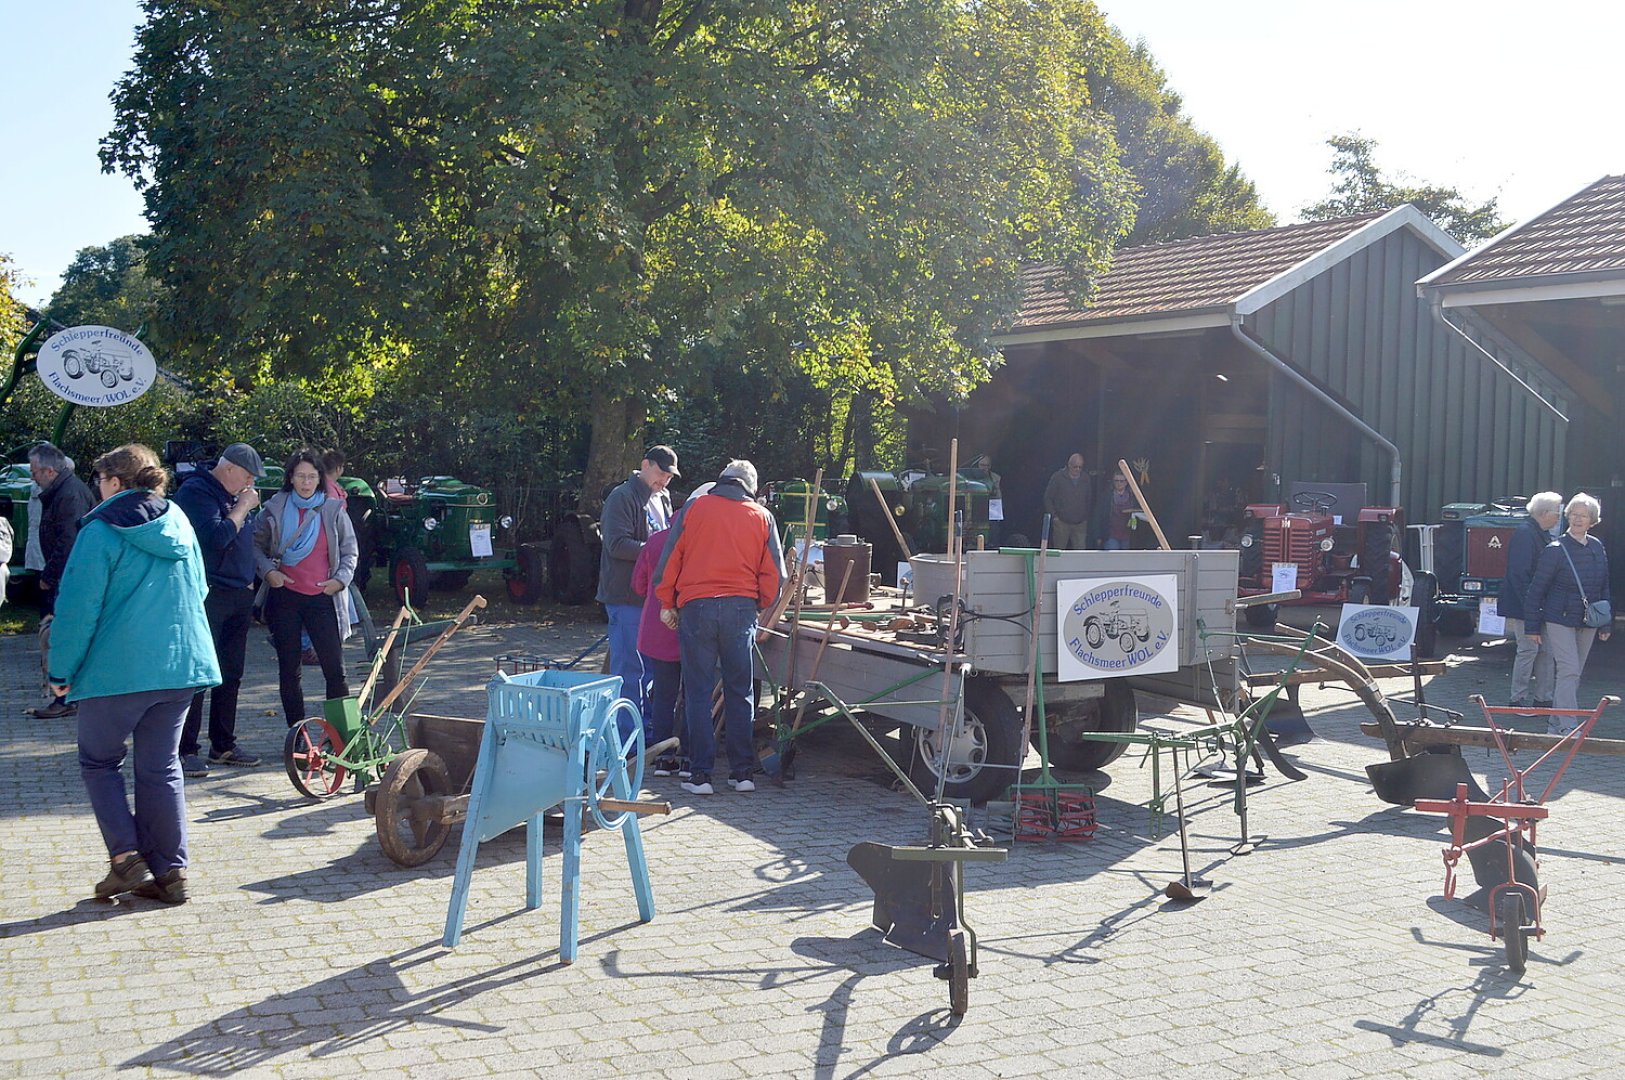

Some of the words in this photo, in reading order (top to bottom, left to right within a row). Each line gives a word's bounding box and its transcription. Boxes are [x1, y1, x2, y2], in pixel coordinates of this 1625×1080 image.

[51, 329, 143, 355] Schlepperfreunde
[131, 377, 147, 393] e.V.
[1073, 585, 1162, 615] Schlepperfreunde
[1350, 610, 1407, 624] Schlepperfreunde
[1069, 637, 1126, 668] Flachsmeer
[1155, 630, 1170, 650] e.V.
